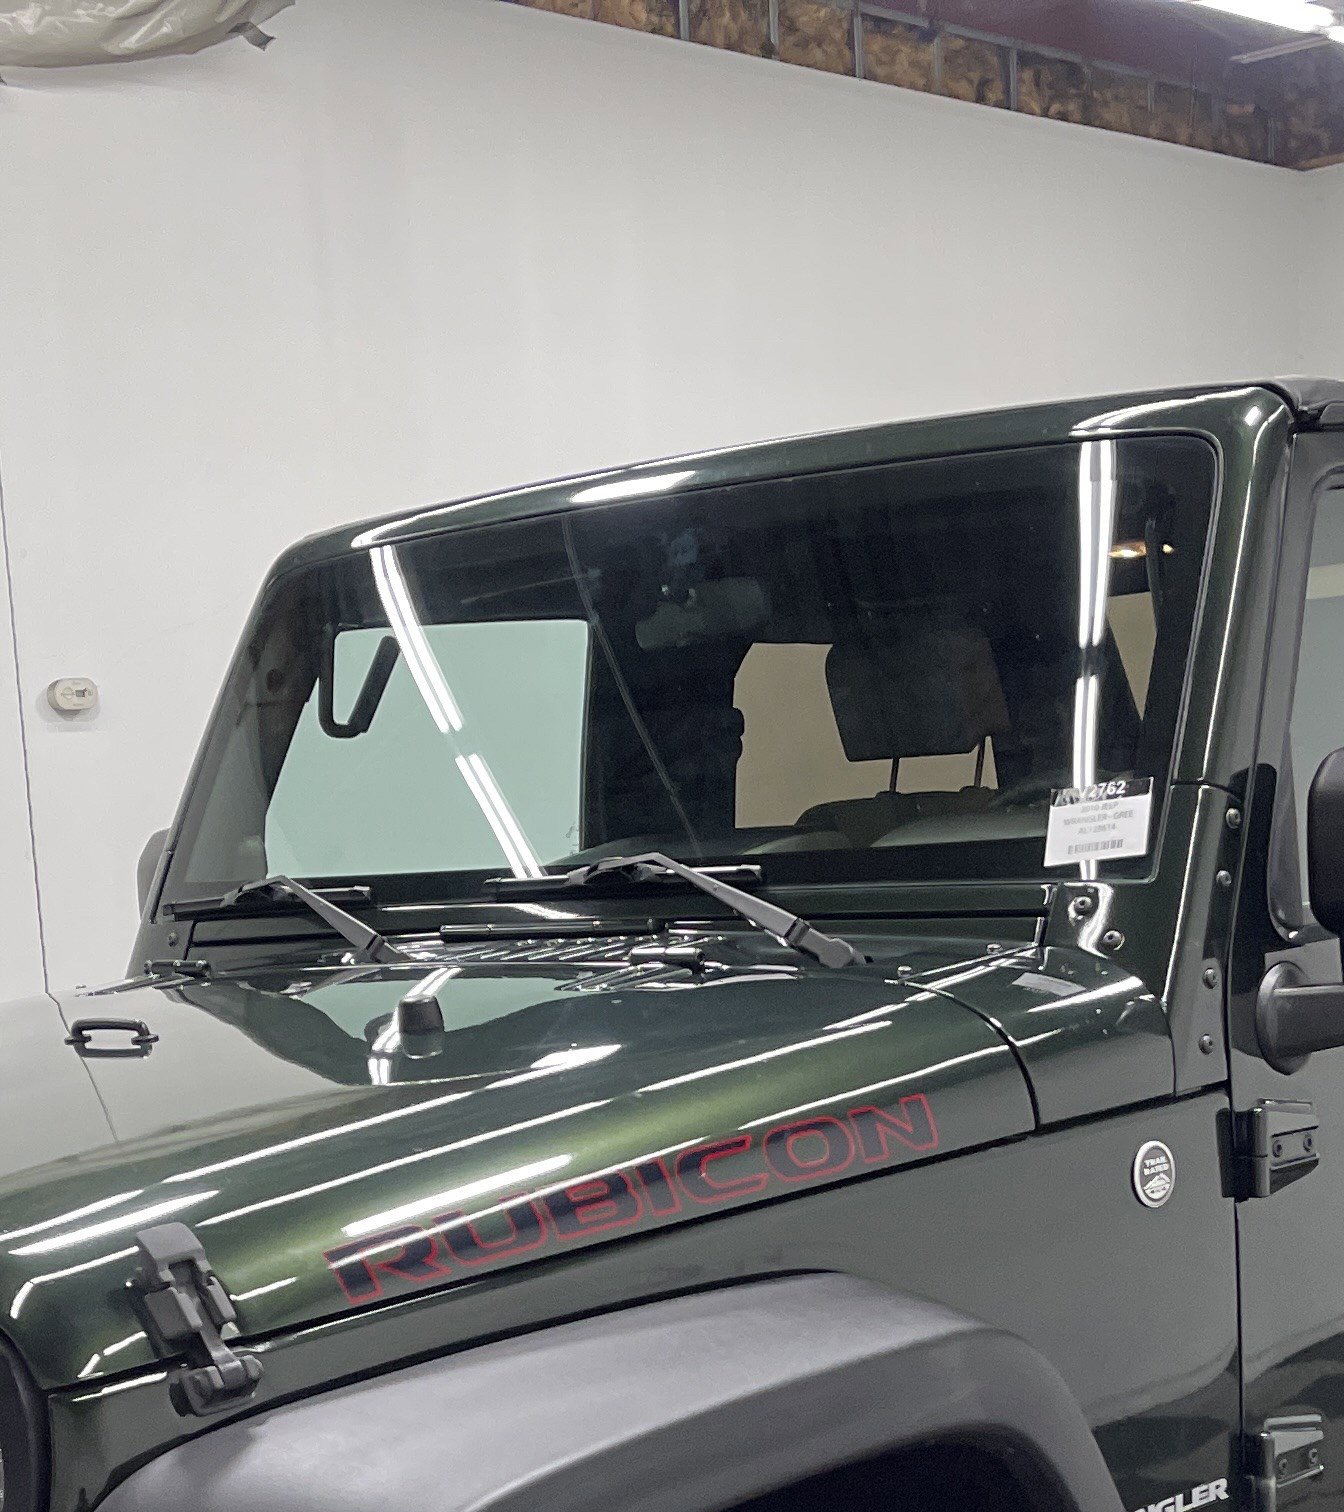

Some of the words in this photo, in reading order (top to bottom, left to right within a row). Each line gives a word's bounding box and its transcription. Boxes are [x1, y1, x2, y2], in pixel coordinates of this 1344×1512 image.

[1143, 1155, 1168, 1168] TRAIL
[1143, 1163, 1170, 1176] RATED
[323, 1093, 940, 1304] RUBICON
